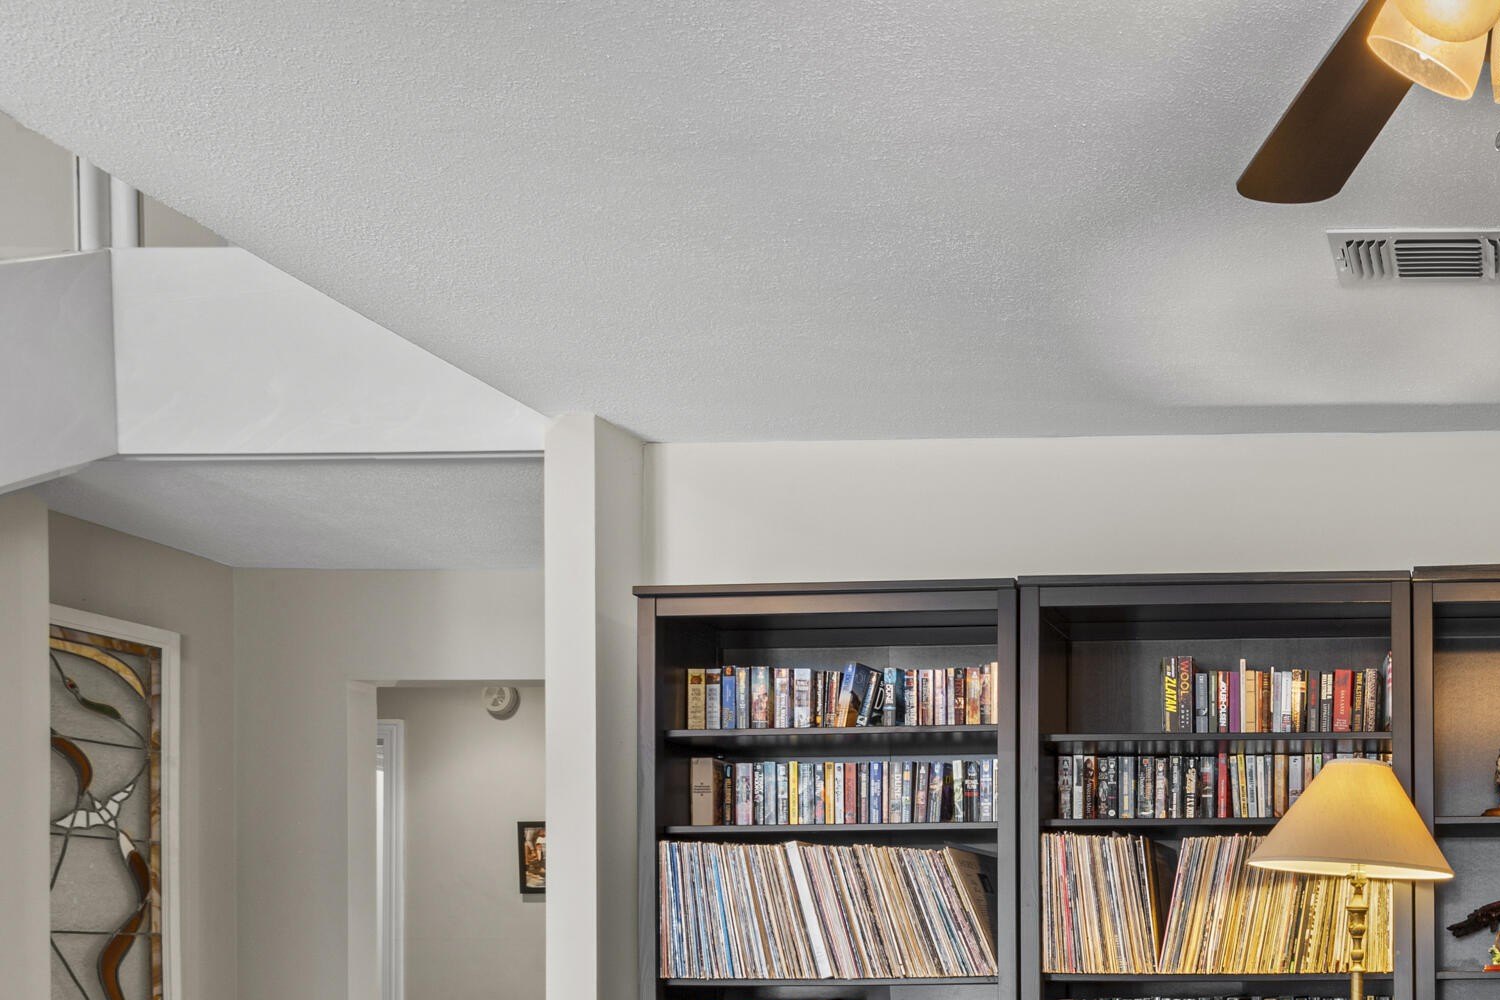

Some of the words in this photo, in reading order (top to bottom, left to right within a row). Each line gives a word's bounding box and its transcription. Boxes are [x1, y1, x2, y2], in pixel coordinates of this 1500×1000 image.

[1164, 676, 1177, 712] ZLATAN
[1180, 660, 1190, 699] WOOL
[894, 773, 902, 800] DUNE
